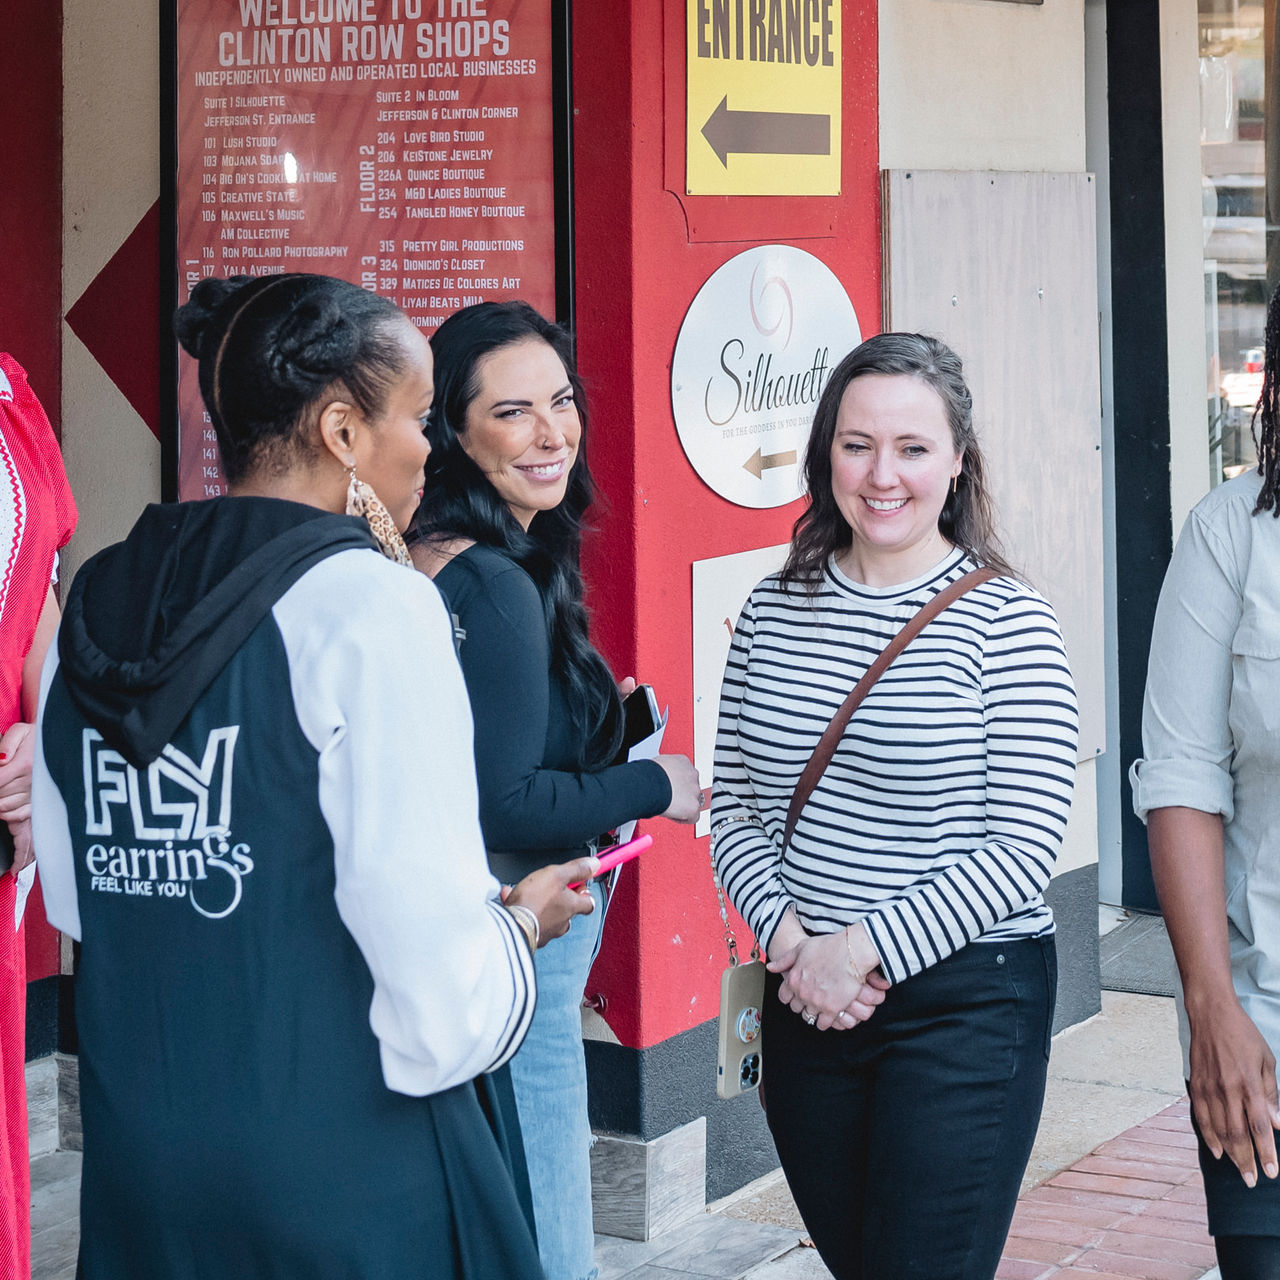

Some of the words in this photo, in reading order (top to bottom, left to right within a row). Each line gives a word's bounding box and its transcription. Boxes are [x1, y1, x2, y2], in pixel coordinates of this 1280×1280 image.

[218, 26, 331, 67] CLINTON
[342, 23, 405, 62] ROW
[416, 19, 510, 59] SHOPS
[195, 68, 280, 87] INDEPENDENTLY
[284, 66, 326, 83] OWNED
[330, 65, 353, 81] AND
[356, 63, 417, 81] OPERATED
[420, 61, 460, 79] LOCAL
[463, 59, 537, 77] BUSINESSES
[404, 90, 411, 102] 2
[431, 108, 438, 119] &
[204, 137, 216, 149] 101
[377, 131, 395, 145] 204
[359, 144, 375, 155] 2
[203, 155, 217, 167] 103
[377, 150, 395, 163] 206
[202, 174, 217, 185] 104
[377, 169, 402, 182] 226A
[359, 160, 376, 213] FLOOR
[202, 191, 216, 204] 105
[378, 188, 397, 201] 234
[405, 187, 426, 200] M&D
[202, 210, 216, 222] 106
[378, 207, 397, 219] 254
[220, 228, 235, 240] AM
[202, 246, 215, 259] 116
[379, 240, 395, 252] 315
[361, 255, 377, 266] 3
[379, 259, 398, 271] 324
[202, 265, 215, 277] 117
[379, 277, 397, 290] 329
[704, 338, 835, 426] Silhouett
[203, 448, 216, 460] 141
[203, 466, 219, 479] 142
[204, 484, 221, 497] 143
[85, 831, 255, 919] earrings
[91, 875, 123, 894] FEEL
[124, 878, 154, 897] LIKE
[156, 881, 187, 898] YOU
